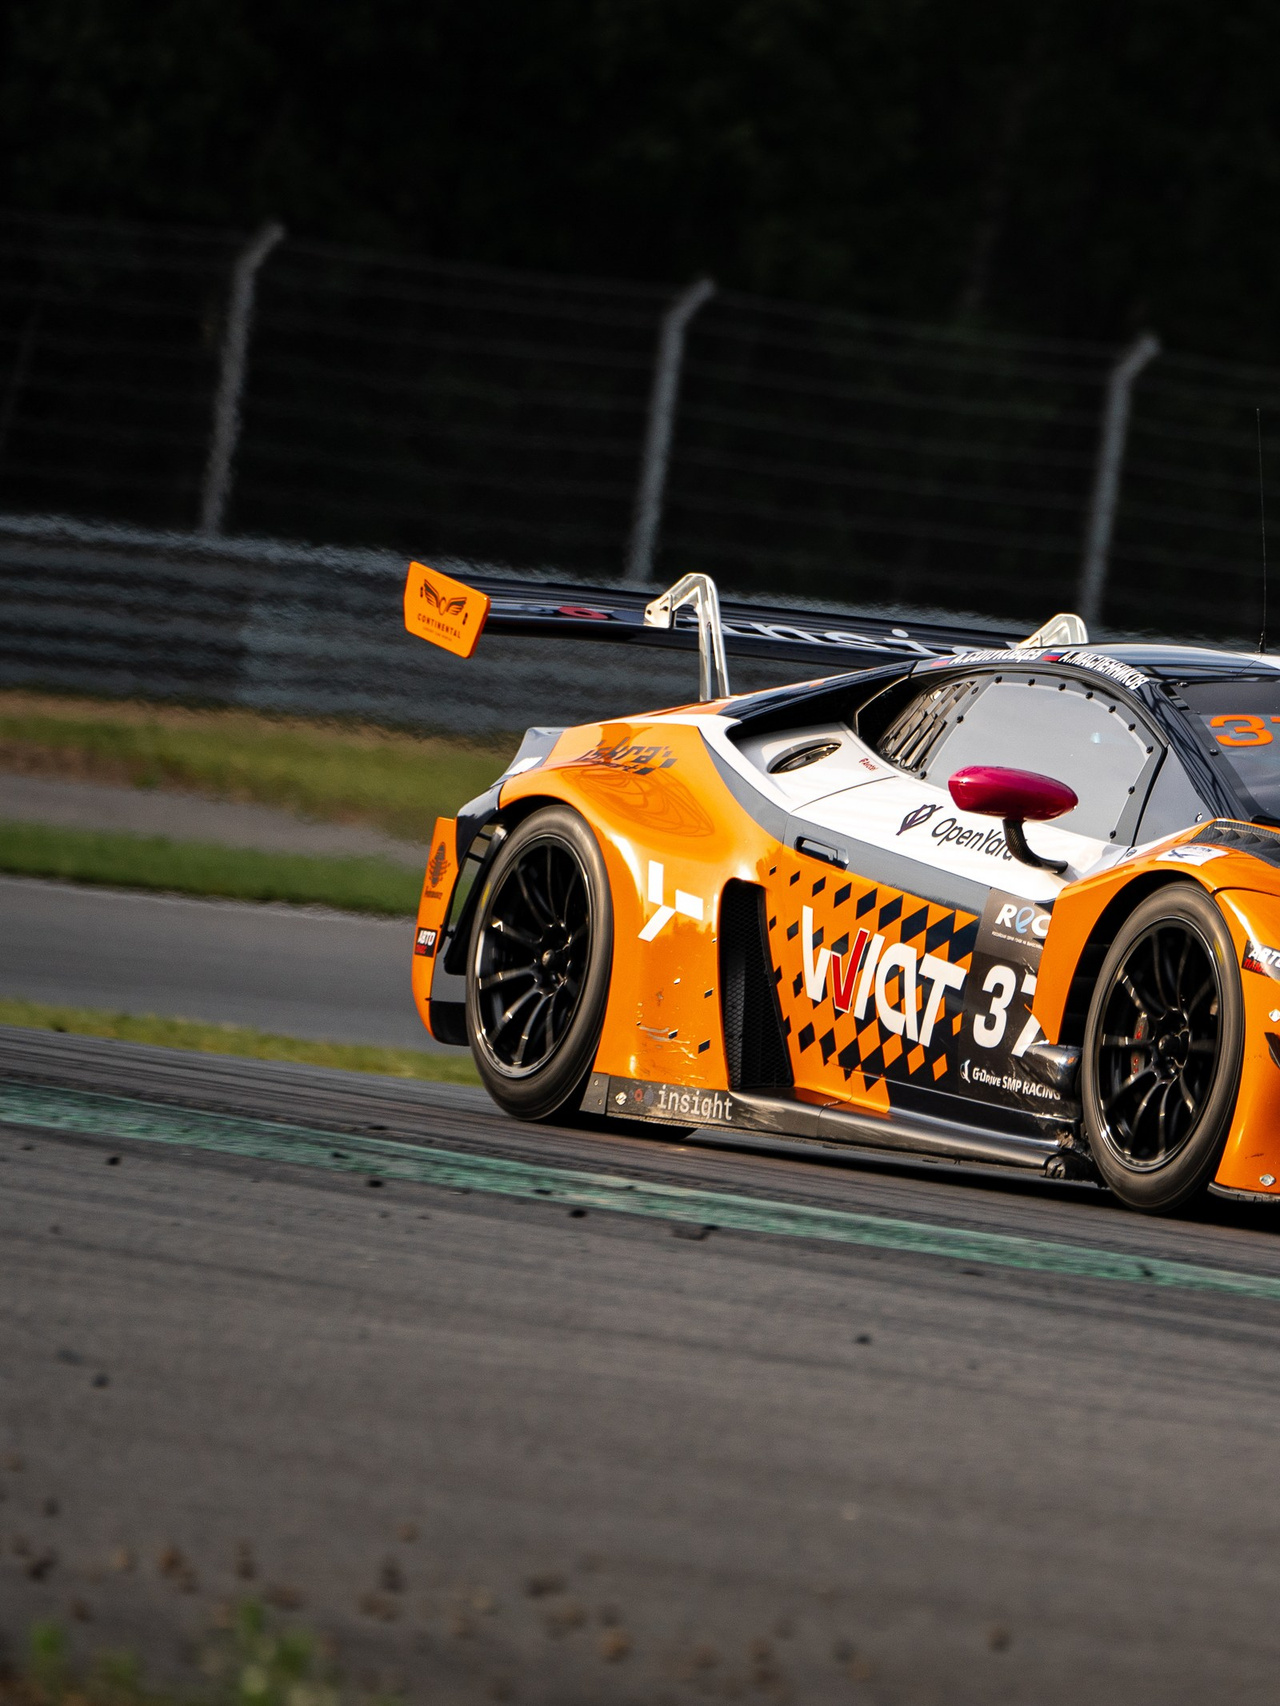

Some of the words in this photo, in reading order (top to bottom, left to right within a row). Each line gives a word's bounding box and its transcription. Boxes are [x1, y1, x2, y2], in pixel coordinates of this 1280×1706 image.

[417, 613, 461, 639] CONTINENTAL
[1002, 1075, 1022, 1093] SMP
[1022, 1080, 1061, 1100] RACING
[657, 1083, 733, 1121] insight
